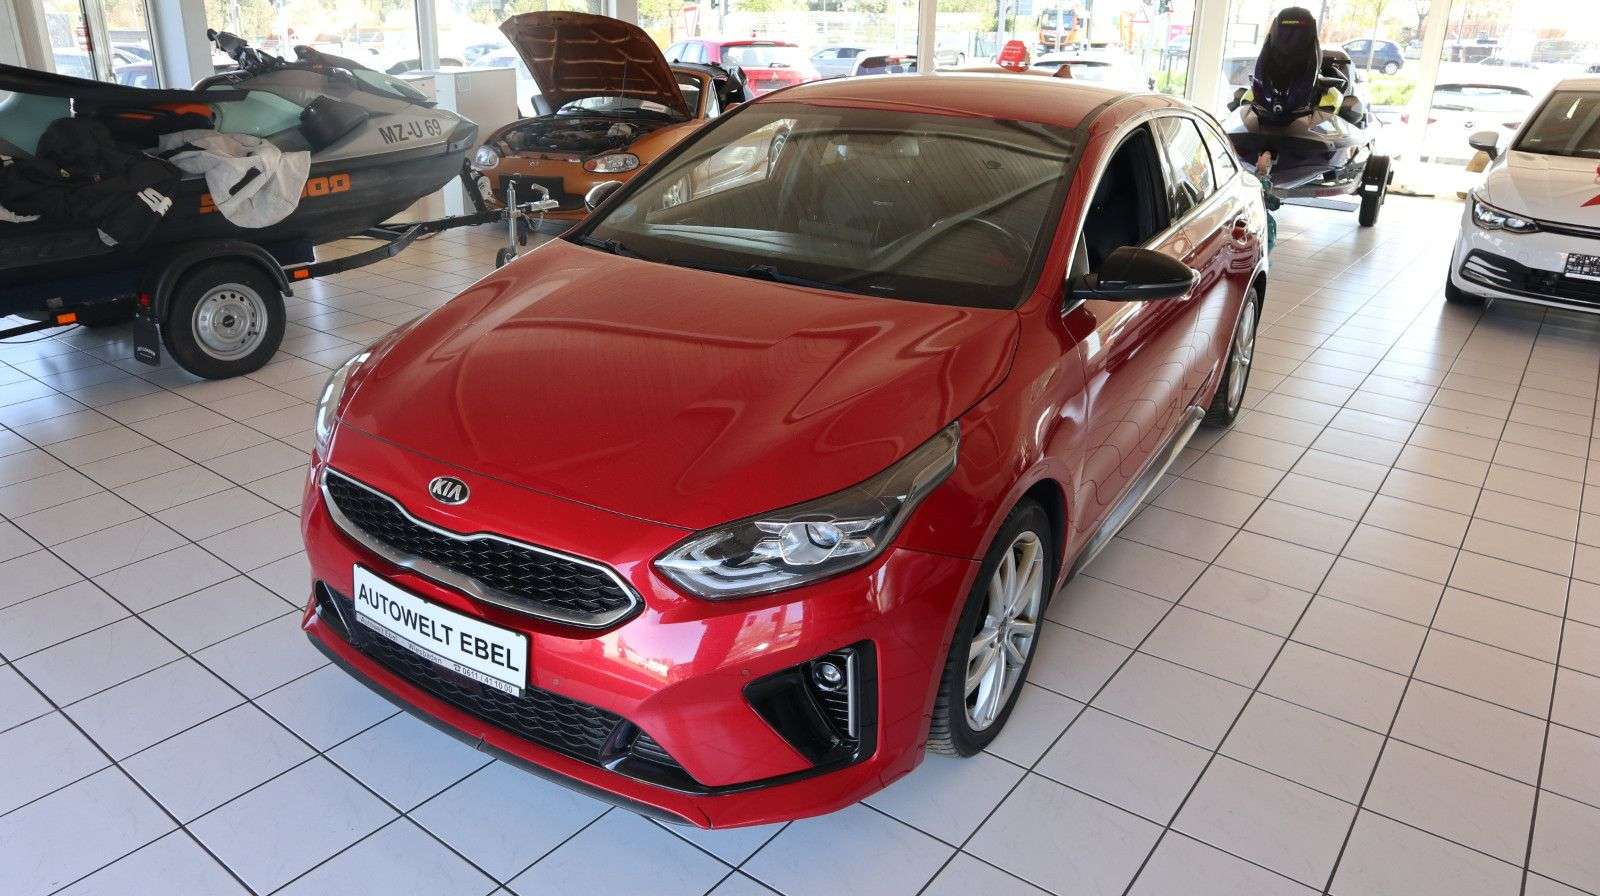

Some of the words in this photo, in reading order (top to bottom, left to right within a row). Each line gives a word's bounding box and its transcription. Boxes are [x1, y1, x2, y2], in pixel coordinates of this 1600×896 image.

[378, 120, 423, 144] MZ-U
[424, 118, 441, 136] 69
[432, 478, 462, 501] KIA
[358, 583, 453, 646] AUTOWELT
[460, 632, 519, 672] EBEL
